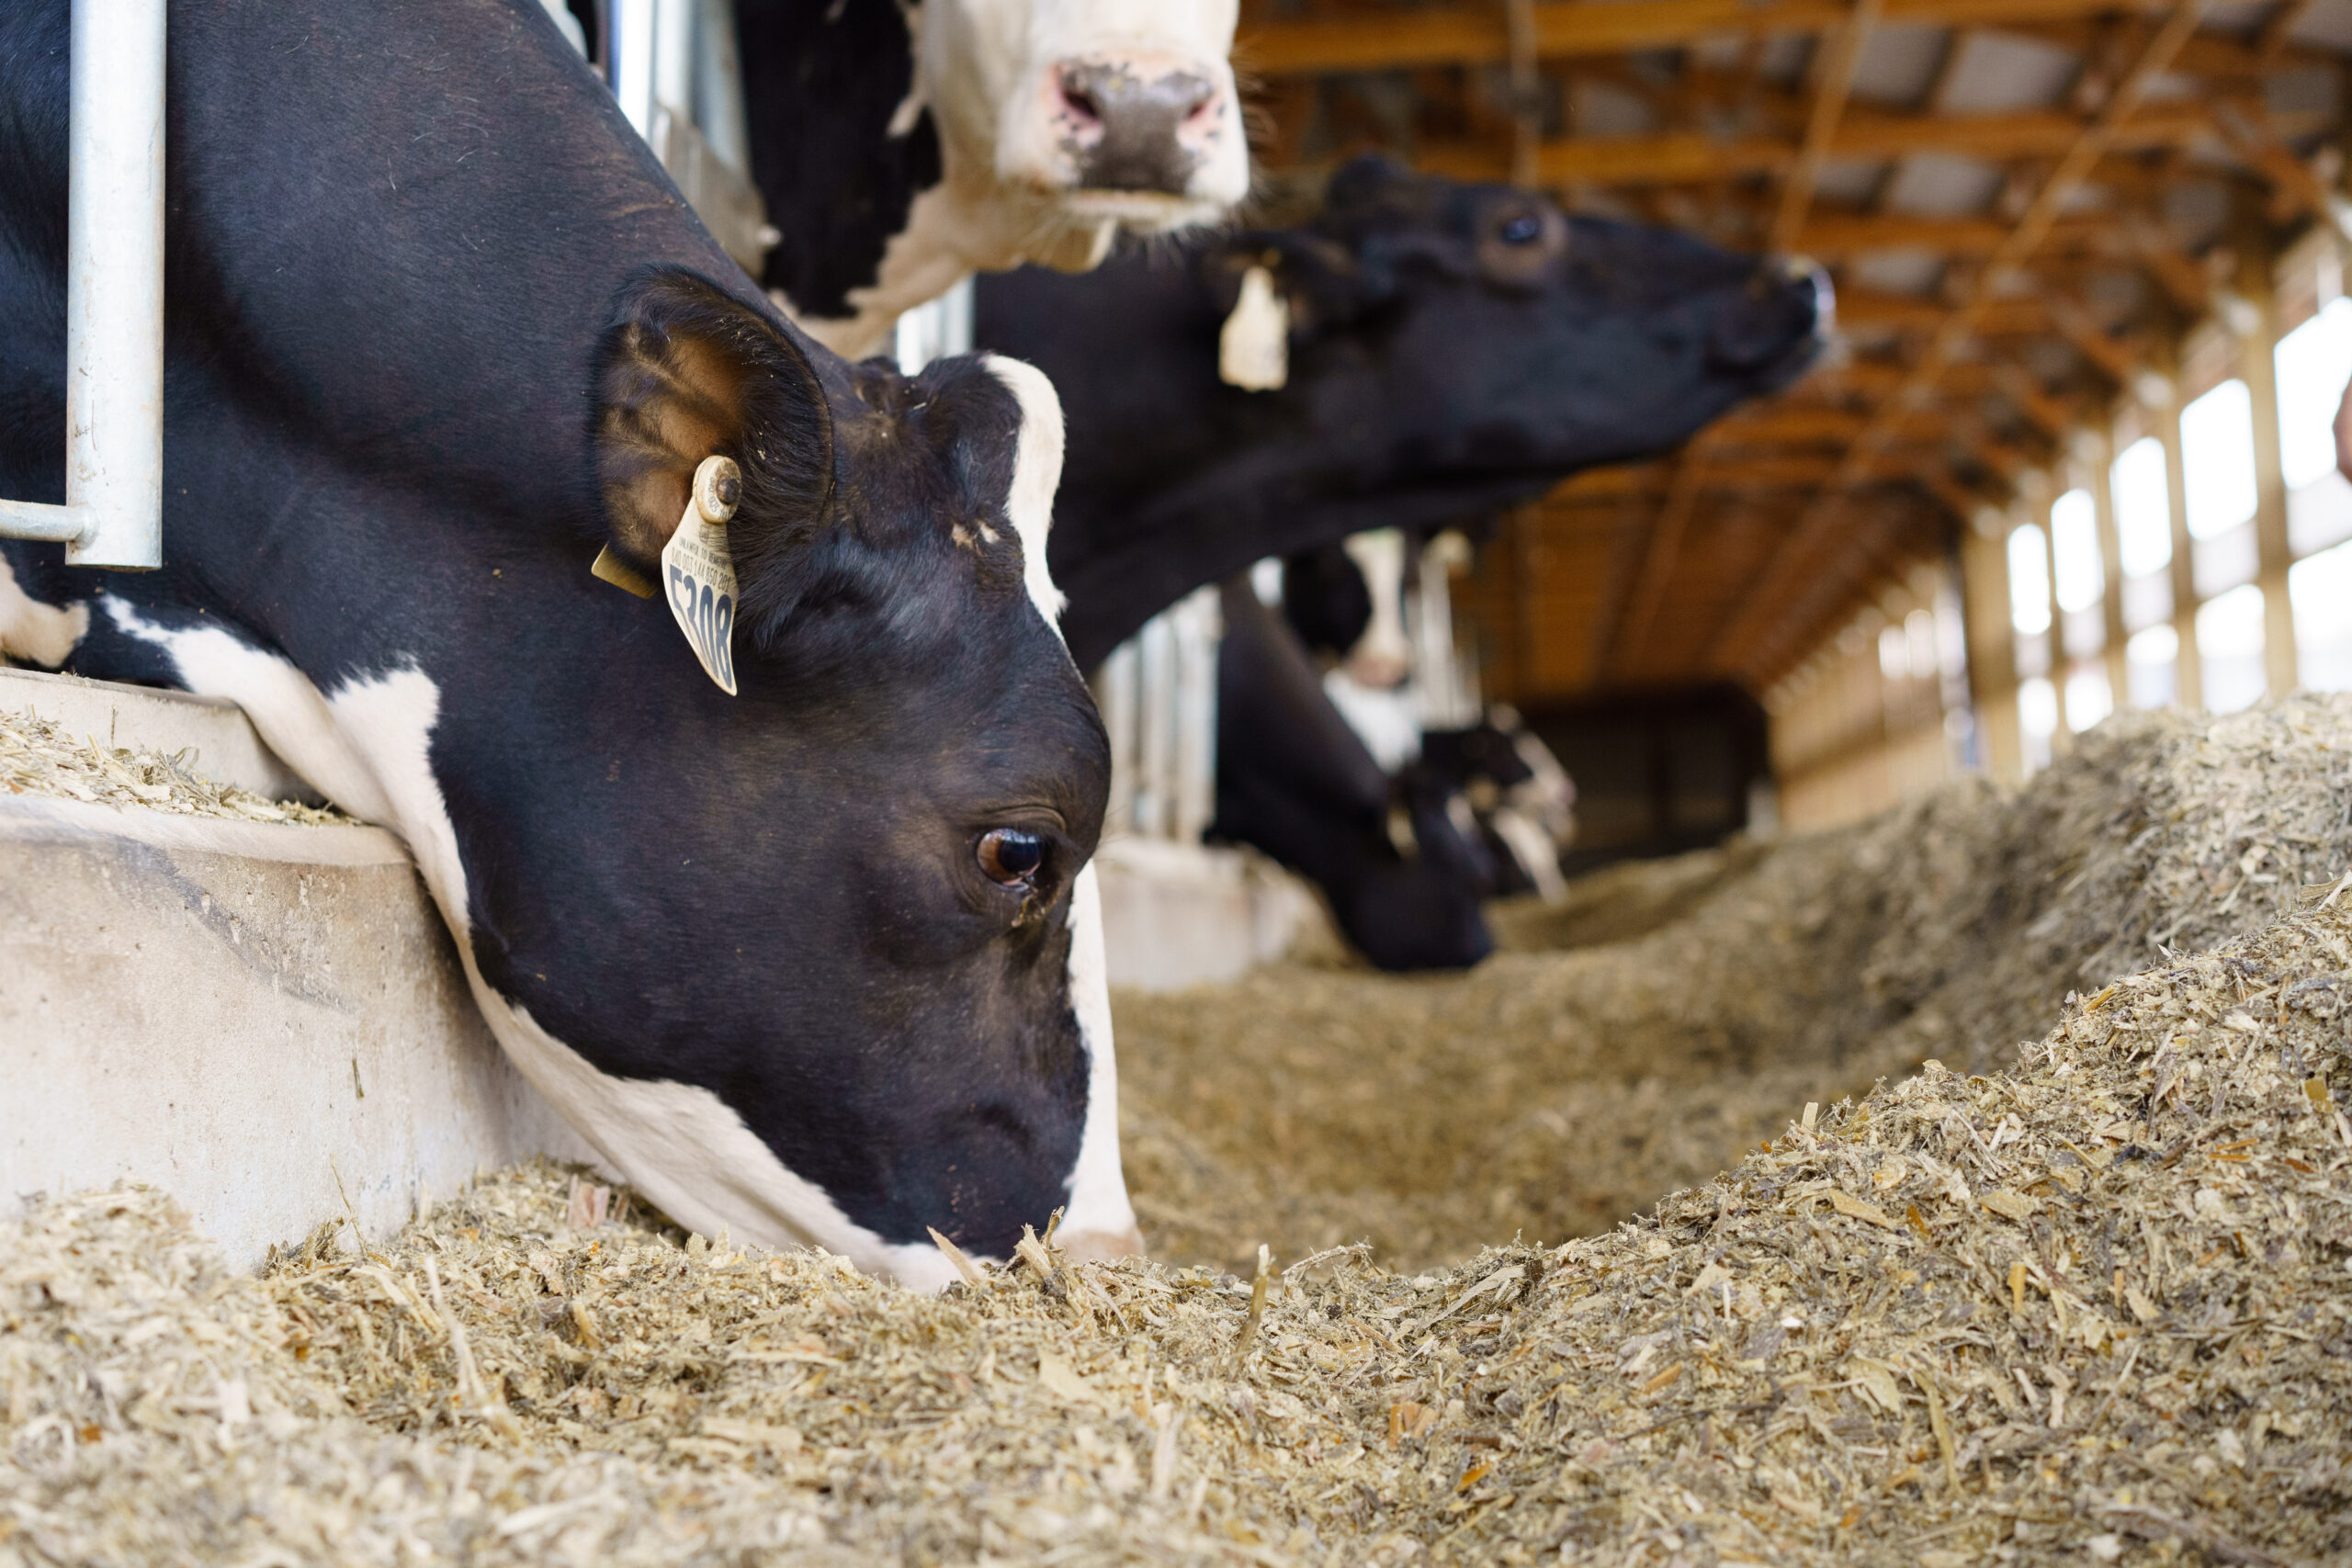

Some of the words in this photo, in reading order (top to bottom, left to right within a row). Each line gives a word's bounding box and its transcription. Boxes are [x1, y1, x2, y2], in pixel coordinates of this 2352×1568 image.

[701, 547, 707, 560] TO
[694, 559, 706, 580] 144
[706, 566, 718, 586] 850
